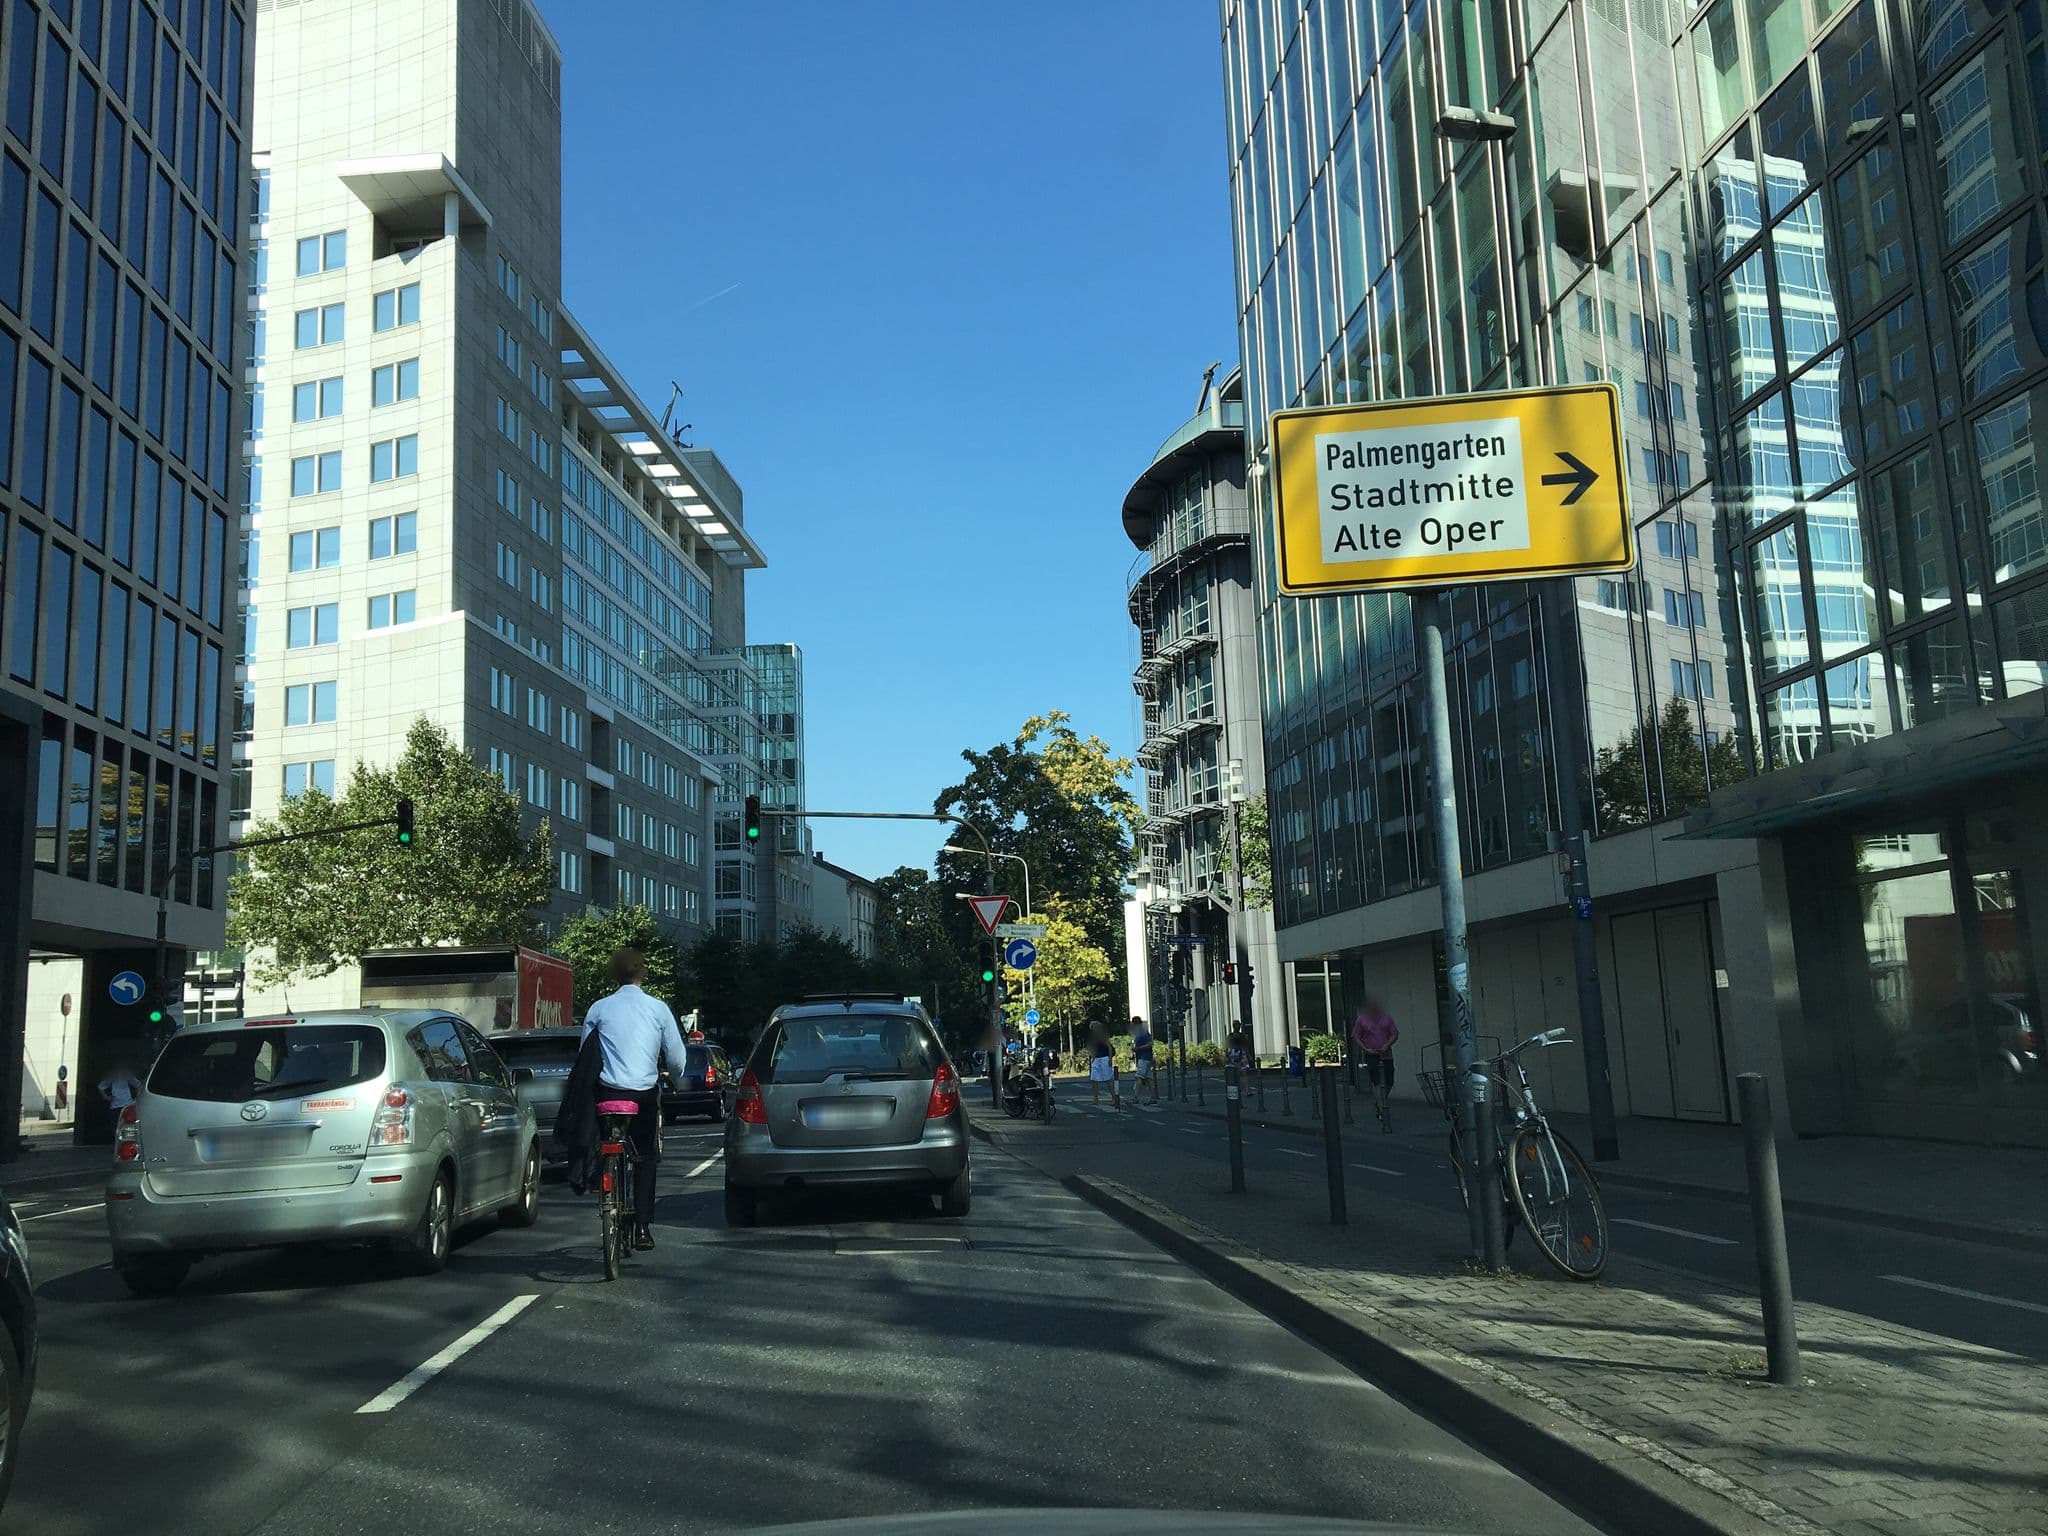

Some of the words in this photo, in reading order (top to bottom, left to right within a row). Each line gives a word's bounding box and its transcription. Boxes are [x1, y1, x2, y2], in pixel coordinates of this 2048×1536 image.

[1326, 434, 1505, 471] Palmengarten
[1330, 473, 1514, 511] Stadtmitte
[1334, 523, 1401, 552] Alte
[1419, 518, 1504, 551] Oper
